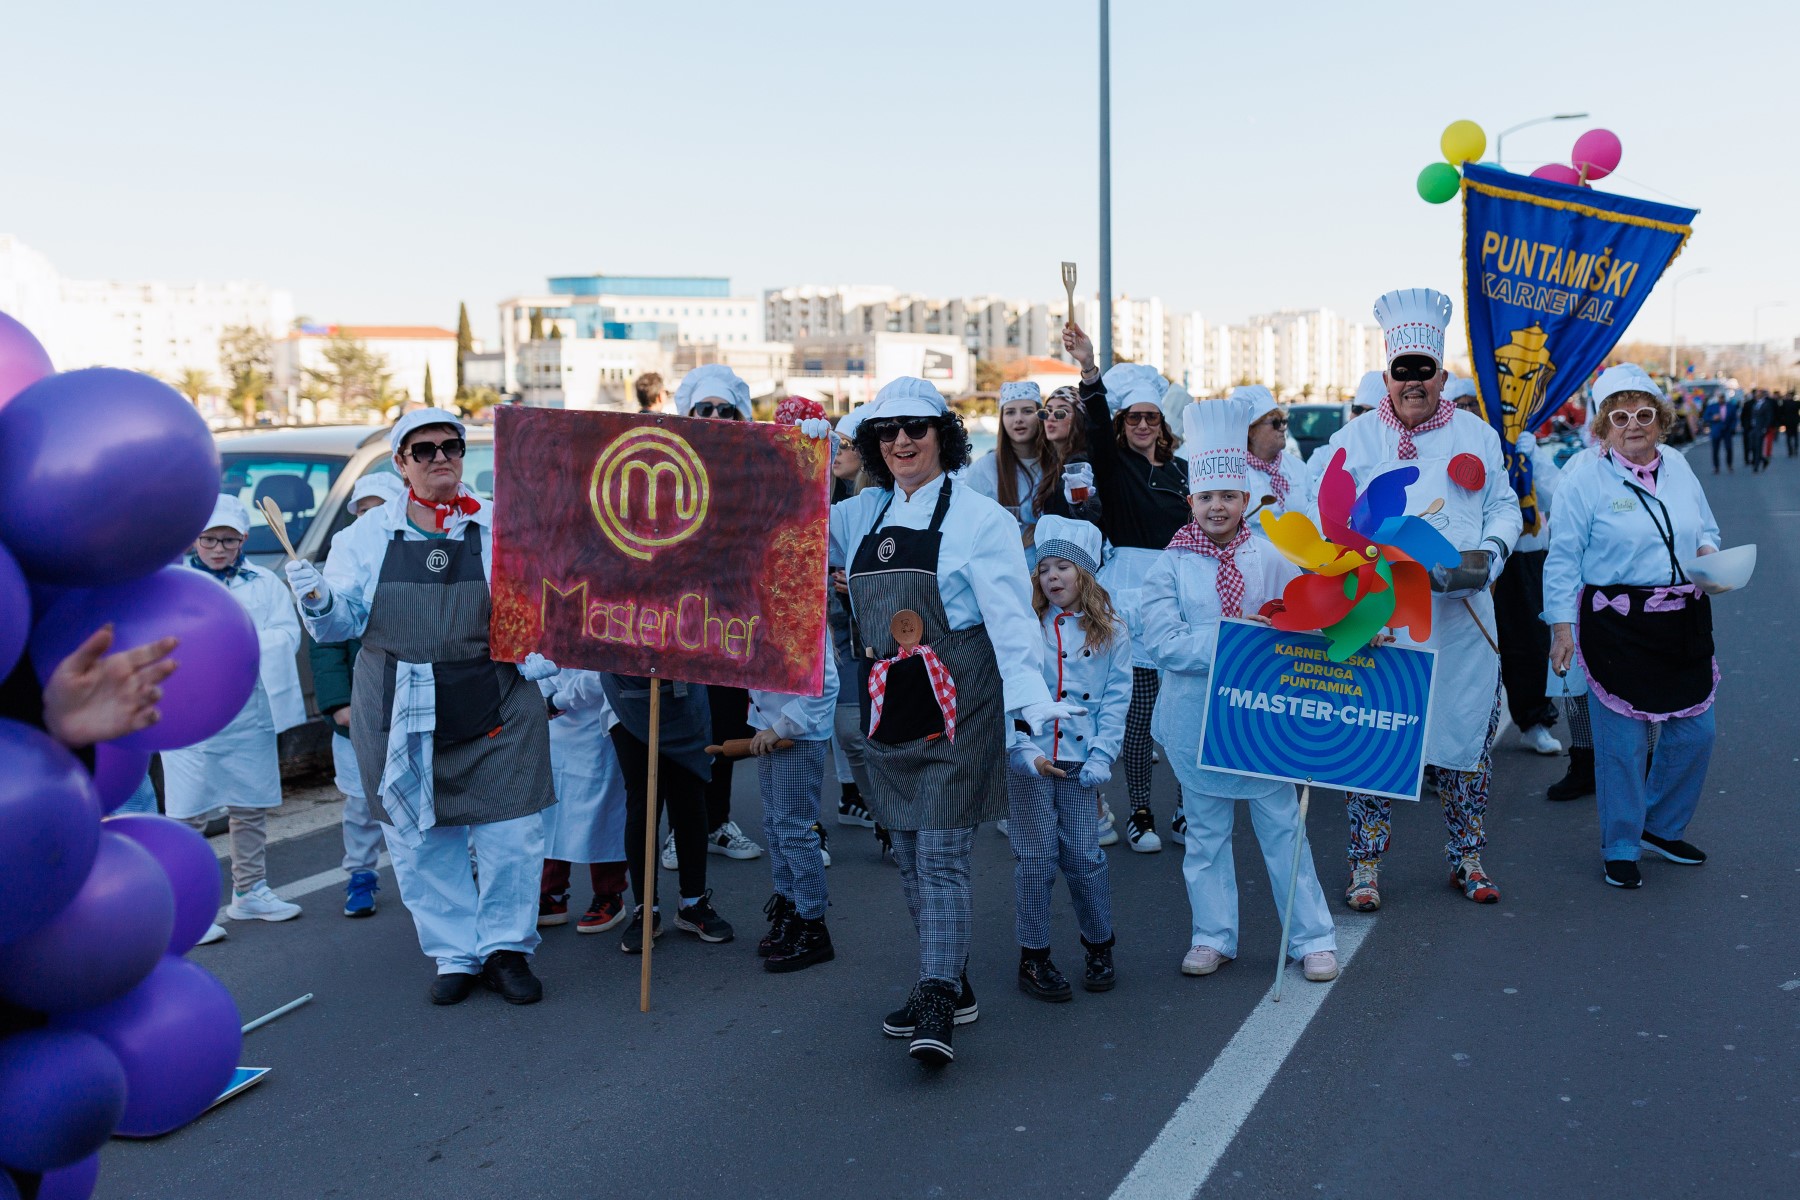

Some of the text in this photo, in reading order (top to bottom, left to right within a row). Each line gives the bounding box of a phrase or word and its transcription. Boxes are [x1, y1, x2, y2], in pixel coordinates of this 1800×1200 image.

[1482, 230, 1639, 298] PUNTAMIŠKI
[1482, 271, 1615, 326] KARNEVAL
[541, 577, 760, 657] MasterChef
[1275, 643, 1376, 669] KARNEVSKA
[1293, 661, 1354, 681] UDRUGA
[1280, 674, 1363, 697] PUNTAMIKA
